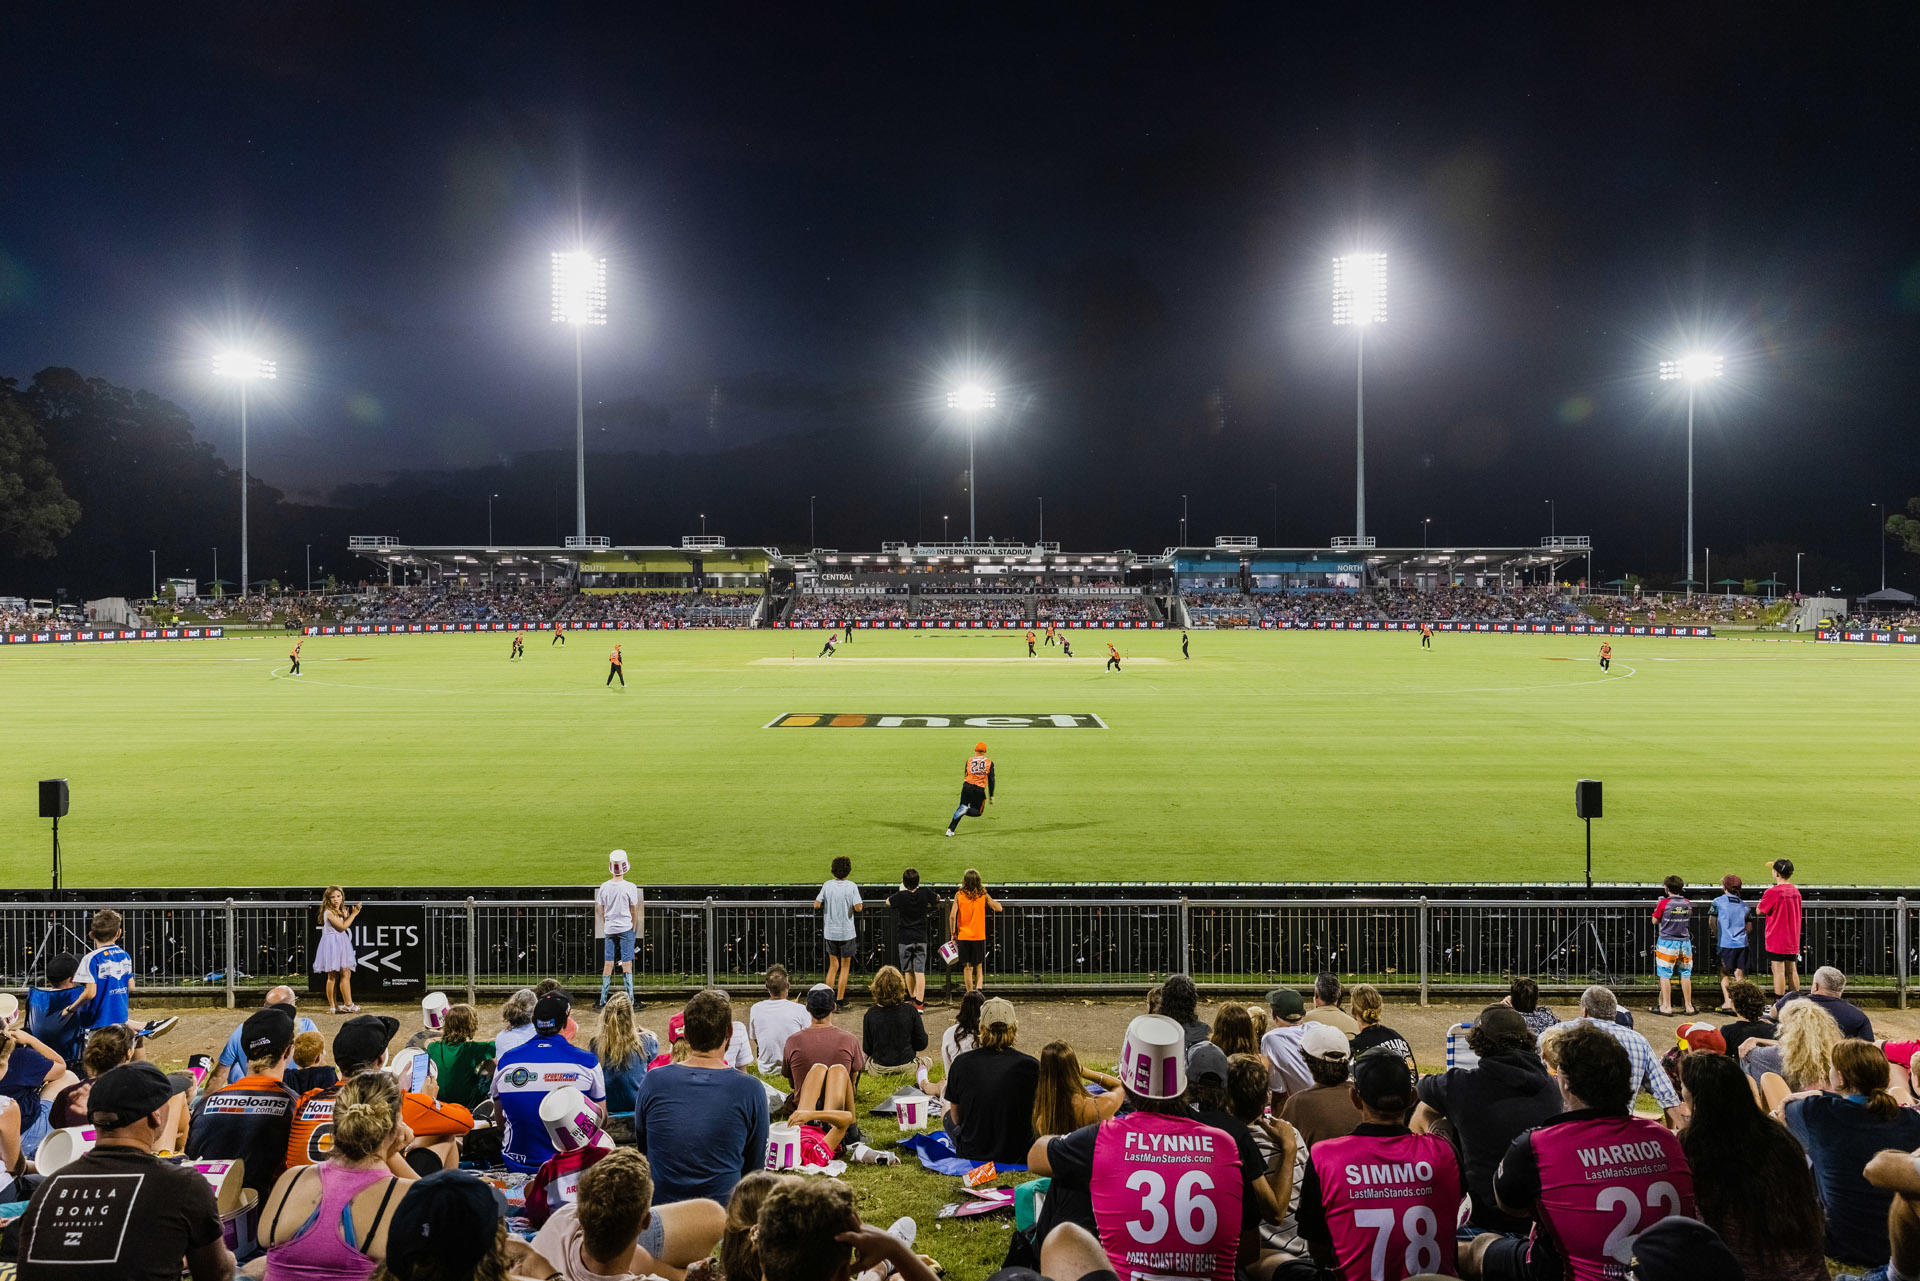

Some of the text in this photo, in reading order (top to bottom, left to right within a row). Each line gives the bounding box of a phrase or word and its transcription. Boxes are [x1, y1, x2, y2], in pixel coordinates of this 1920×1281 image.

[936, 548, 997, 556] INTERNATIONAL
[997, 548, 1033, 556] STADIUM
[579, 564, 606, 572] SOUTH
[821, 573, 854, 581] CENTRAL
[779, 714, 1088, 728] iinet
[316, 925, 419, 947] ILETS
[207, 1096, 287, 1108] Homeloans
[1125, 1131, 1214, 1152] FLYNNIE
[1124, 1151, 1212, 1163] LastManStands.com
[1576, 1140, 1666, 1168] WARRIOR
[1345, 1161, 1434, 1185] SIMMO
[1585, 1162, 1668, 1180] LastManStands.com
[59, 1188, 117, 1199] BILLA
[1349, 1186, 1433, 1199] LastManStands.com
[55, 1205, 110, 1216] BONG
[1125, 1169, 1218, 1245] 36
[1354, 1205, 1441, 1281] 78
[1150, 1252, 1174, 1270] COAST
[1176, 1252, 1194, 1272] EASY
[1195, 1253, 1217, 1273] BEATS
